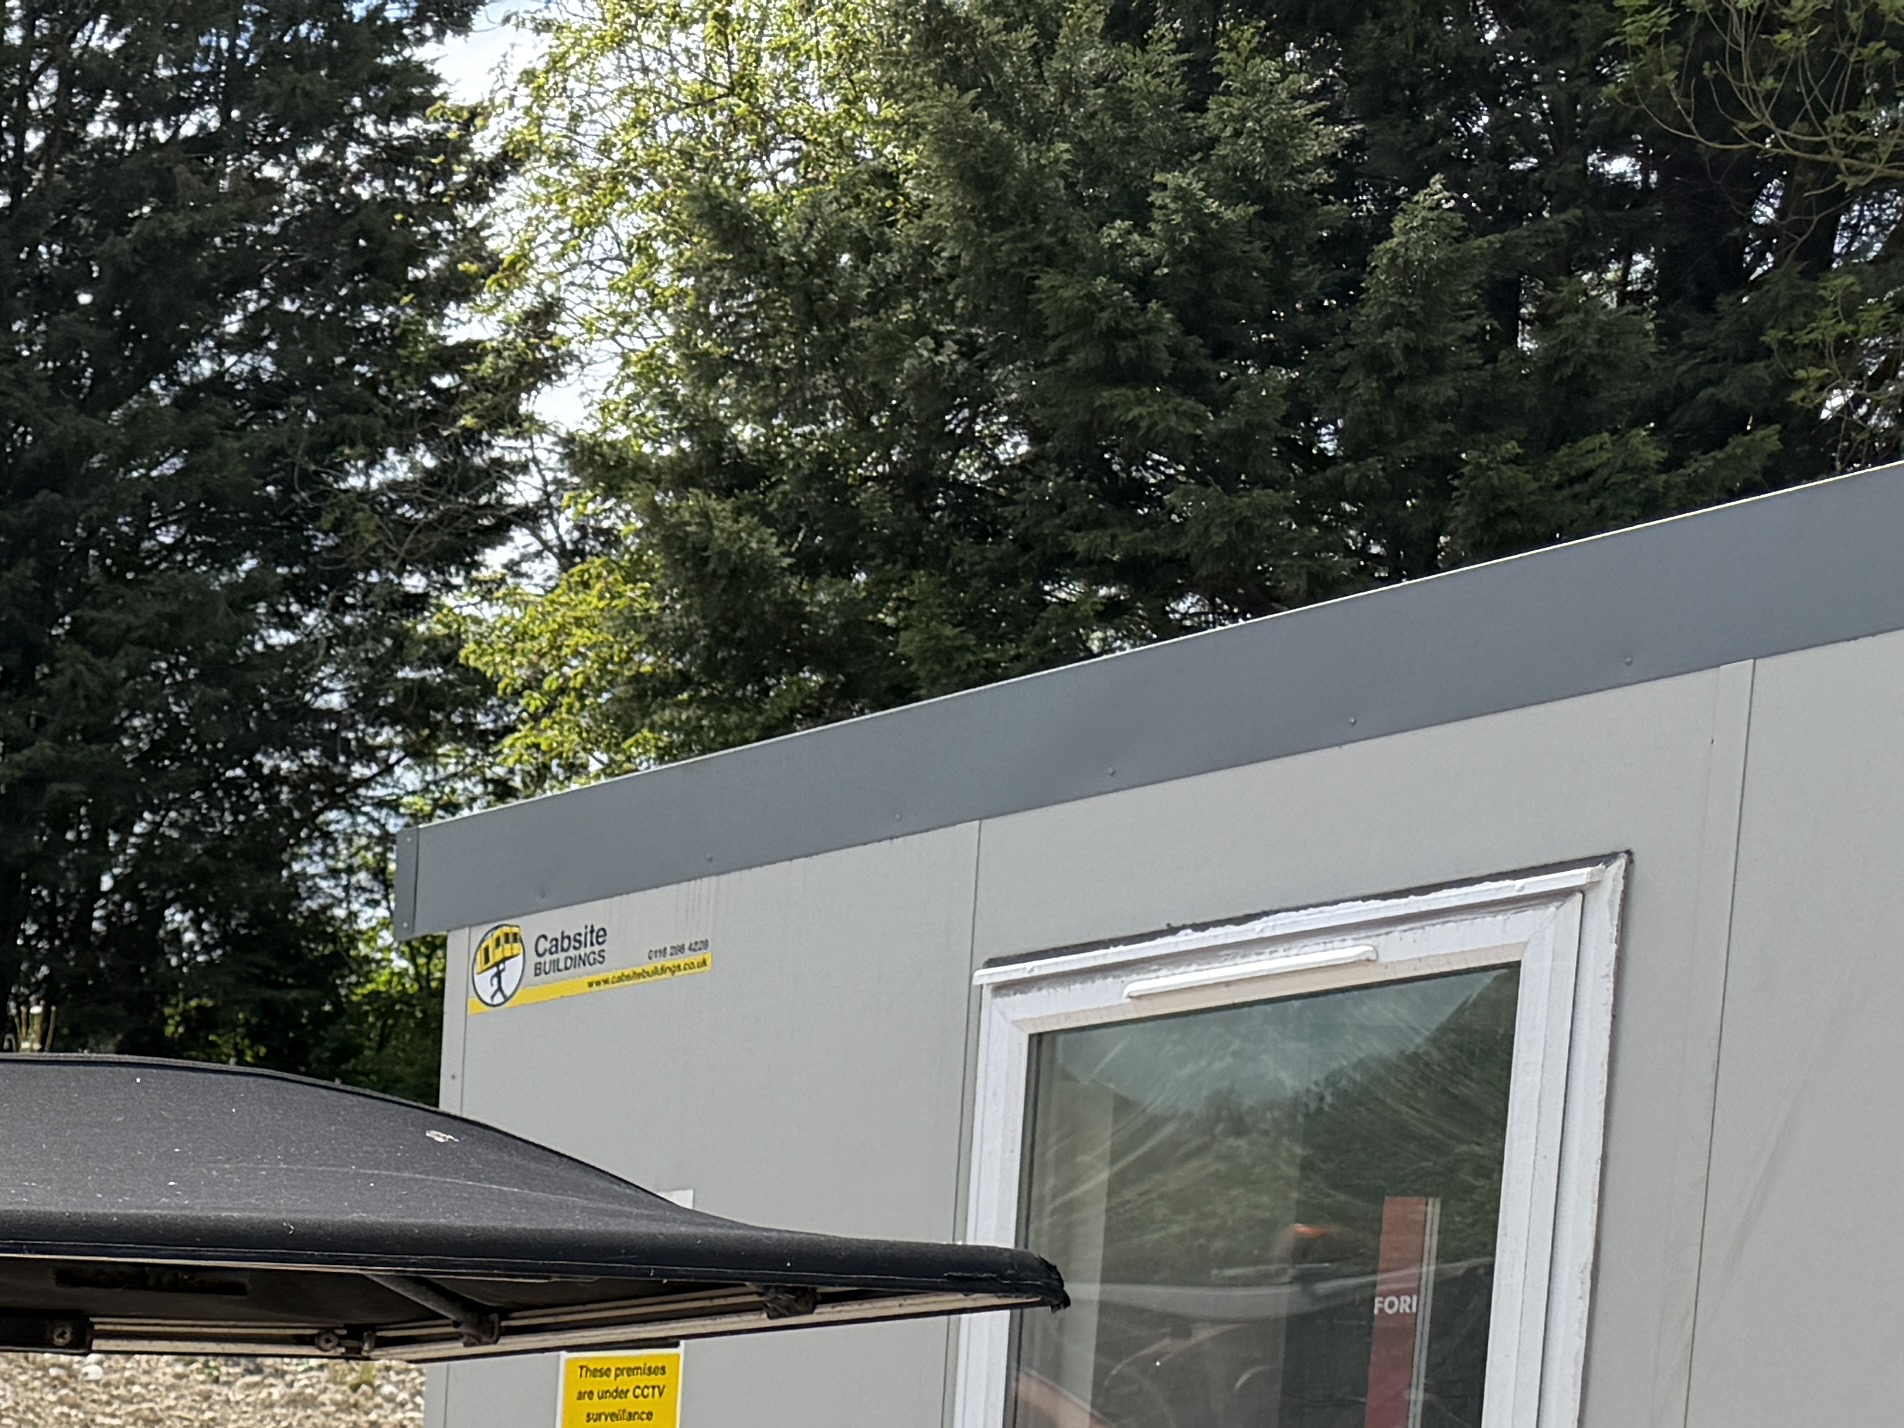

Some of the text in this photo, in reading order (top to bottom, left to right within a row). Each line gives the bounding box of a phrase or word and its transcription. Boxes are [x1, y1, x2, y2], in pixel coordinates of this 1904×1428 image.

[534, 924, 608, 958] Cabsite
[533, 948, 606, 977] BUILDINGS
[578, 1363, 666, 1381] These premises
[576, 1384, 666, 1401] are under CCTV
[586, 1409, 653, 1423] surveillance
